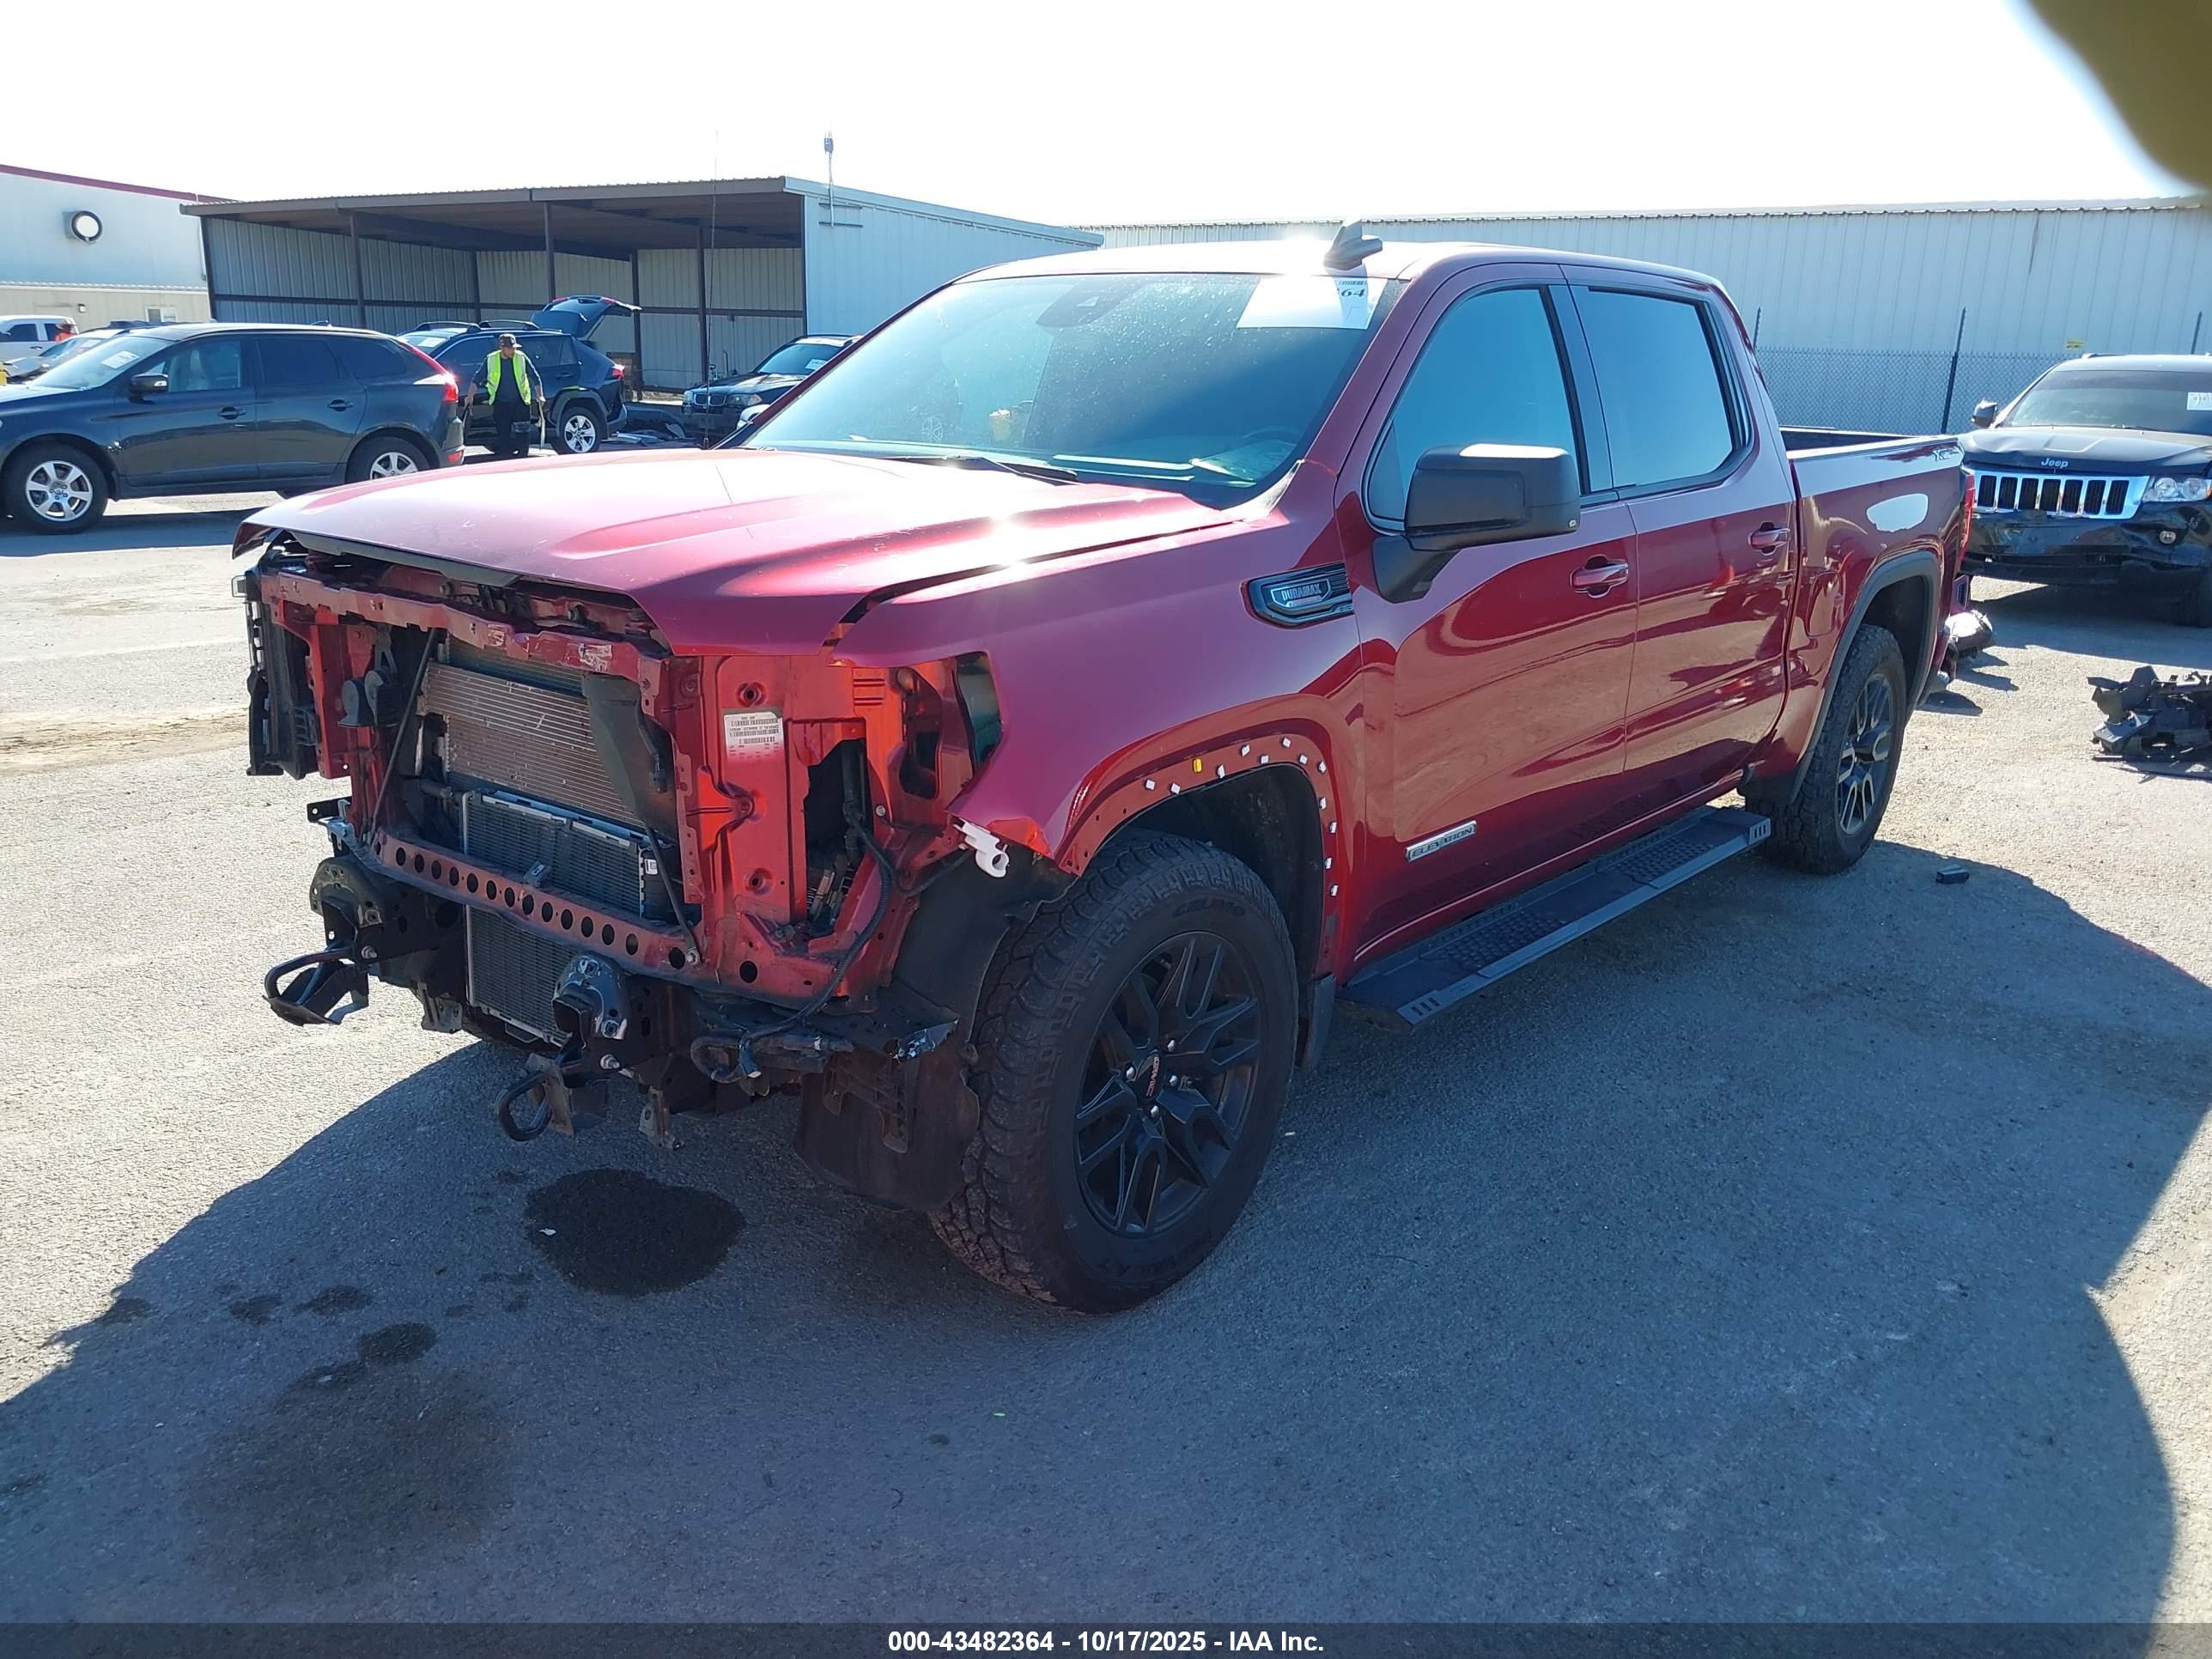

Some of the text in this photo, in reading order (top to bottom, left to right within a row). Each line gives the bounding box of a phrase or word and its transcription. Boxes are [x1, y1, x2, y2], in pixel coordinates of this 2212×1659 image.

[2040, 458, 2069, 469] Jeep
[1281, 583, 1322, 601] DURAMAX
[1412, 827, 1473, 857] ELEVATION
[1146, 1057, 1160, 1097] GMC
